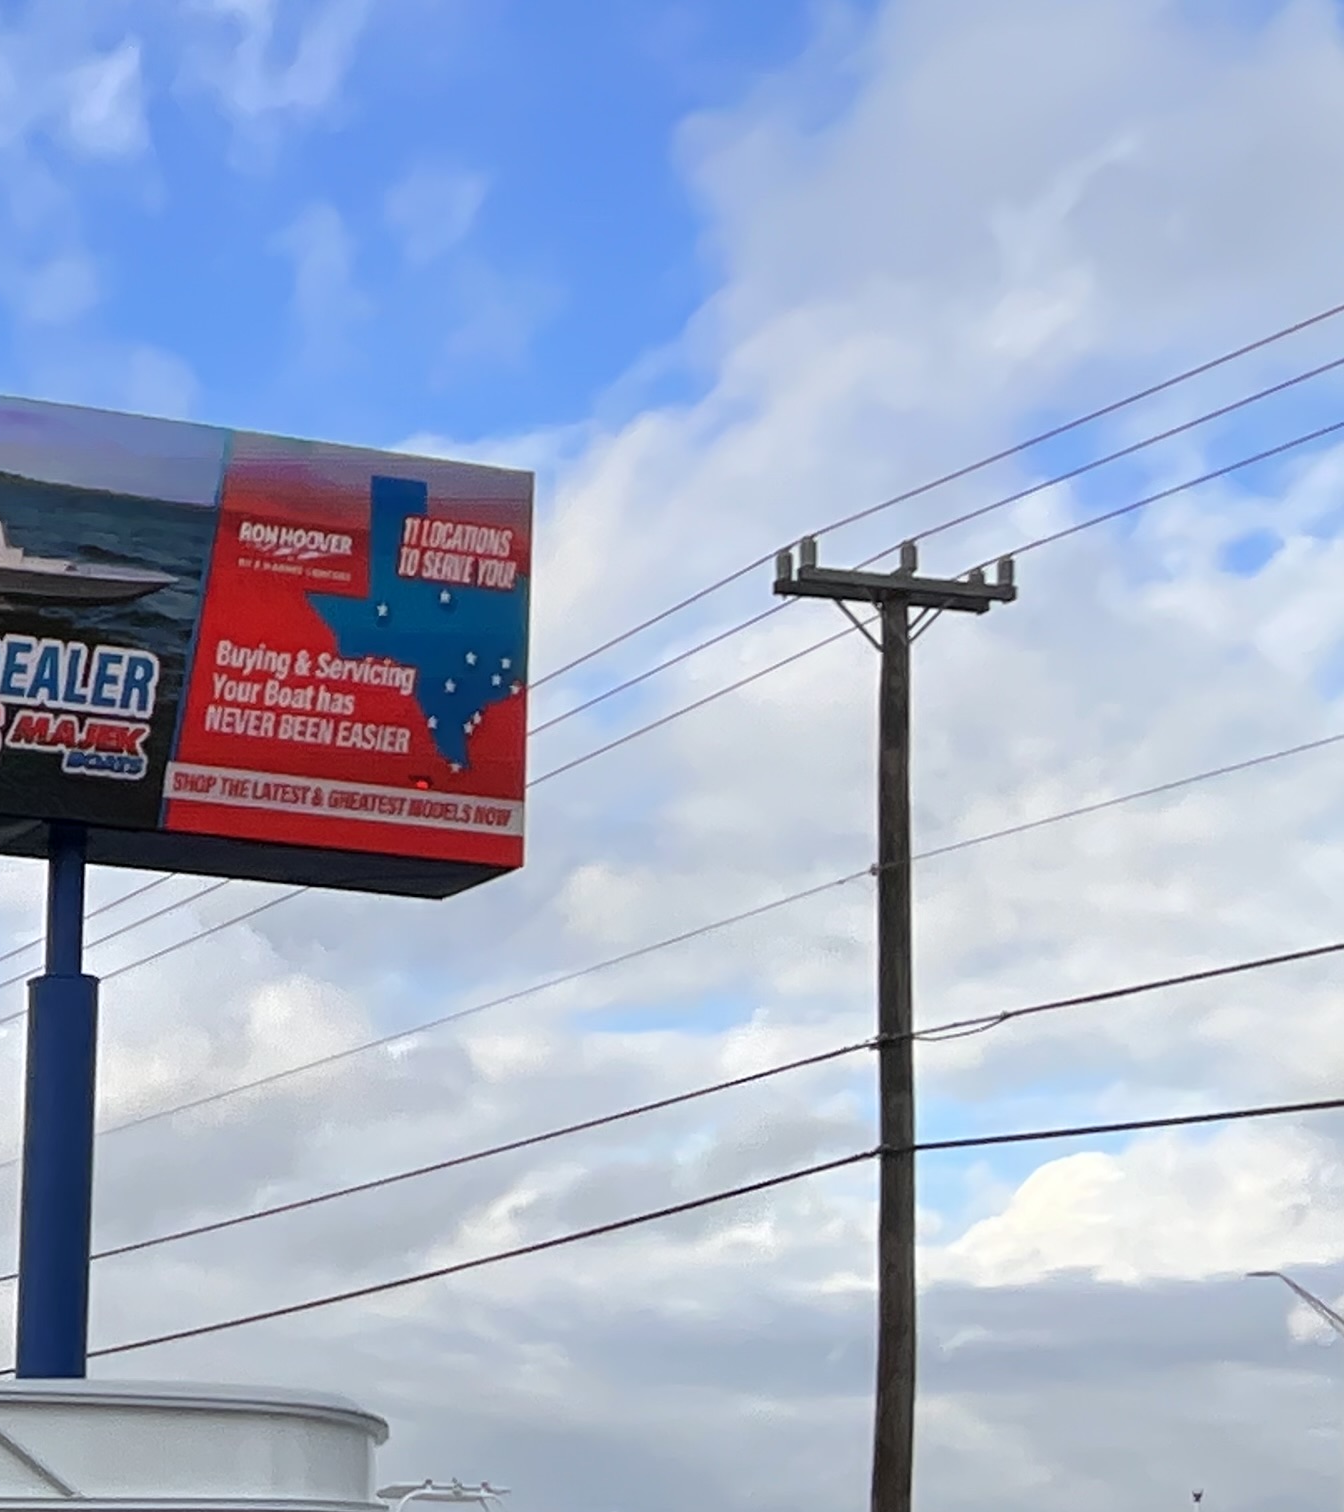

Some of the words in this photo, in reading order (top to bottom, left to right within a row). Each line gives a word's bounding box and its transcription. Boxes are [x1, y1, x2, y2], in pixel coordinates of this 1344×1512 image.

[238, 521, 279, 546] RON
[279, 526, 352, 555] HOOVER
[422, 519, 512, 557] LOCATIONS
[421, 551, 472, 584] SERVE
[215, 639, 292, 680] Buying
[294, 649, 312, 677] &
[314, 651, 417, 696] Servicing
[212, 671, 262, 704] Your
[263, 678, 314, 711] Boat
[315, 684, 355, 716] has
[10, 714, 148, 757] MAJEK
[204, 703, 276, 738] NEVER
[278, 713, 335, 745] BEEN
[335, 720, 411, 754] EASIER
[64, 750, 145, 776] BOATS
[172, 771, 218, 794] SHOP
[219, 776, 250, 799] THE
[251, 782, 311, 807] LATEST
[327, 790, 407, 817] GREATEST
[410, 799, 474, 826] MODELS
